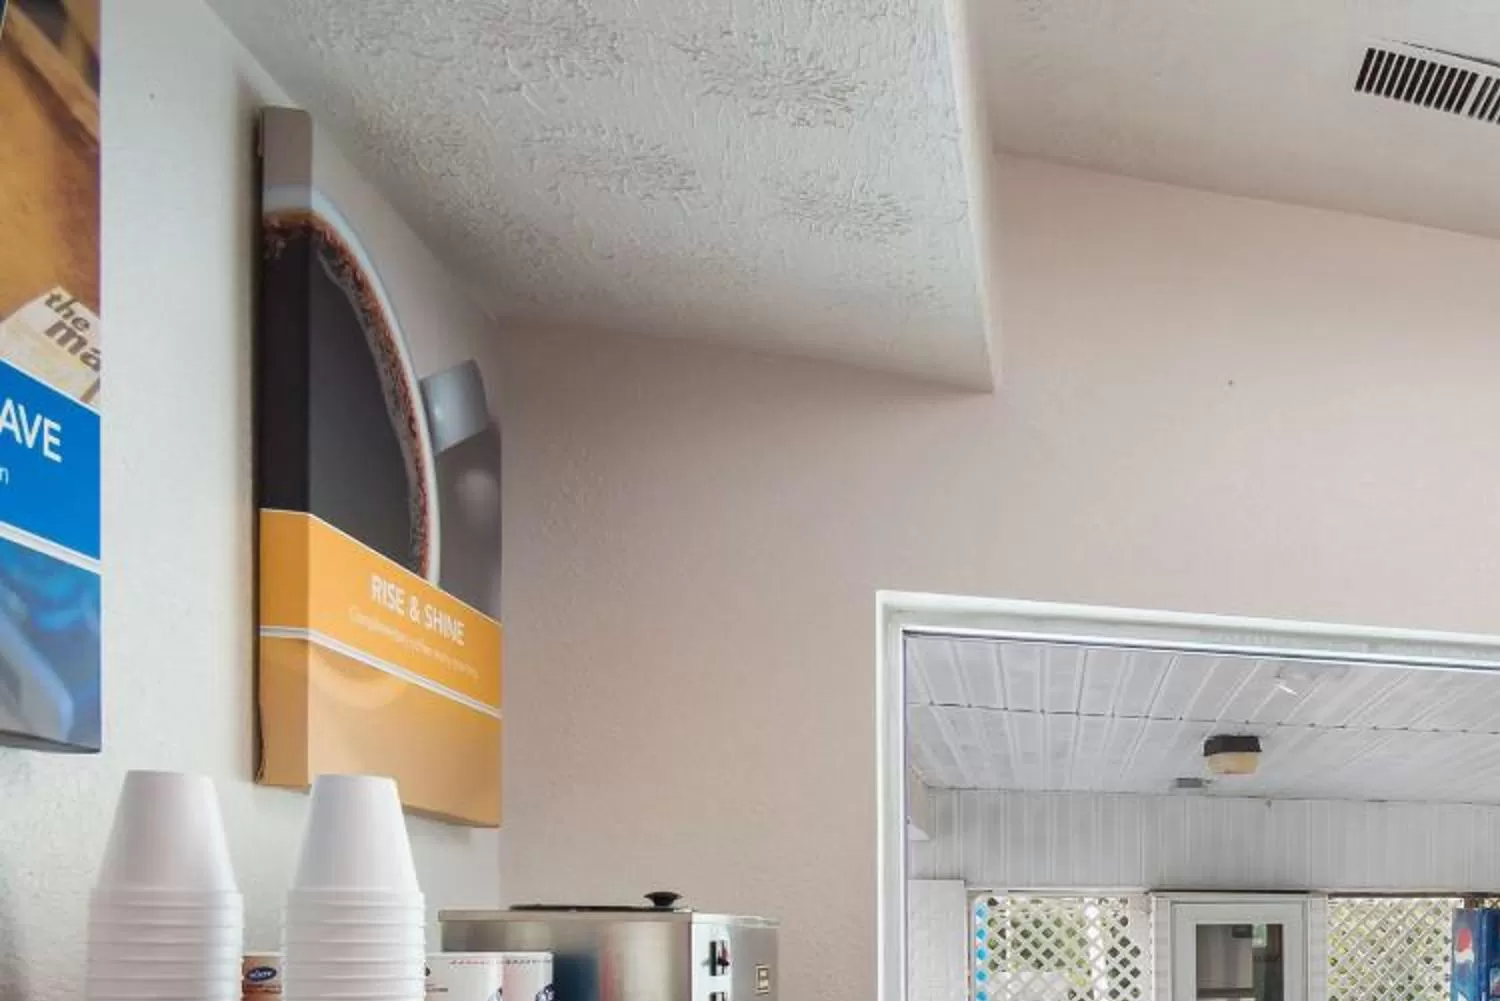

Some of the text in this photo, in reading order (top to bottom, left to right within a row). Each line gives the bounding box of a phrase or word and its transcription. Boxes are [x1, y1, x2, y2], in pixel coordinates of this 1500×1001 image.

[45, 293, 90, 331] the
[0, 398, 62, 463] AVE
[371, 574, 405, 616] RISE
[409, 596, 420, 623] &
[424, 603, 465, 647] SHINE
